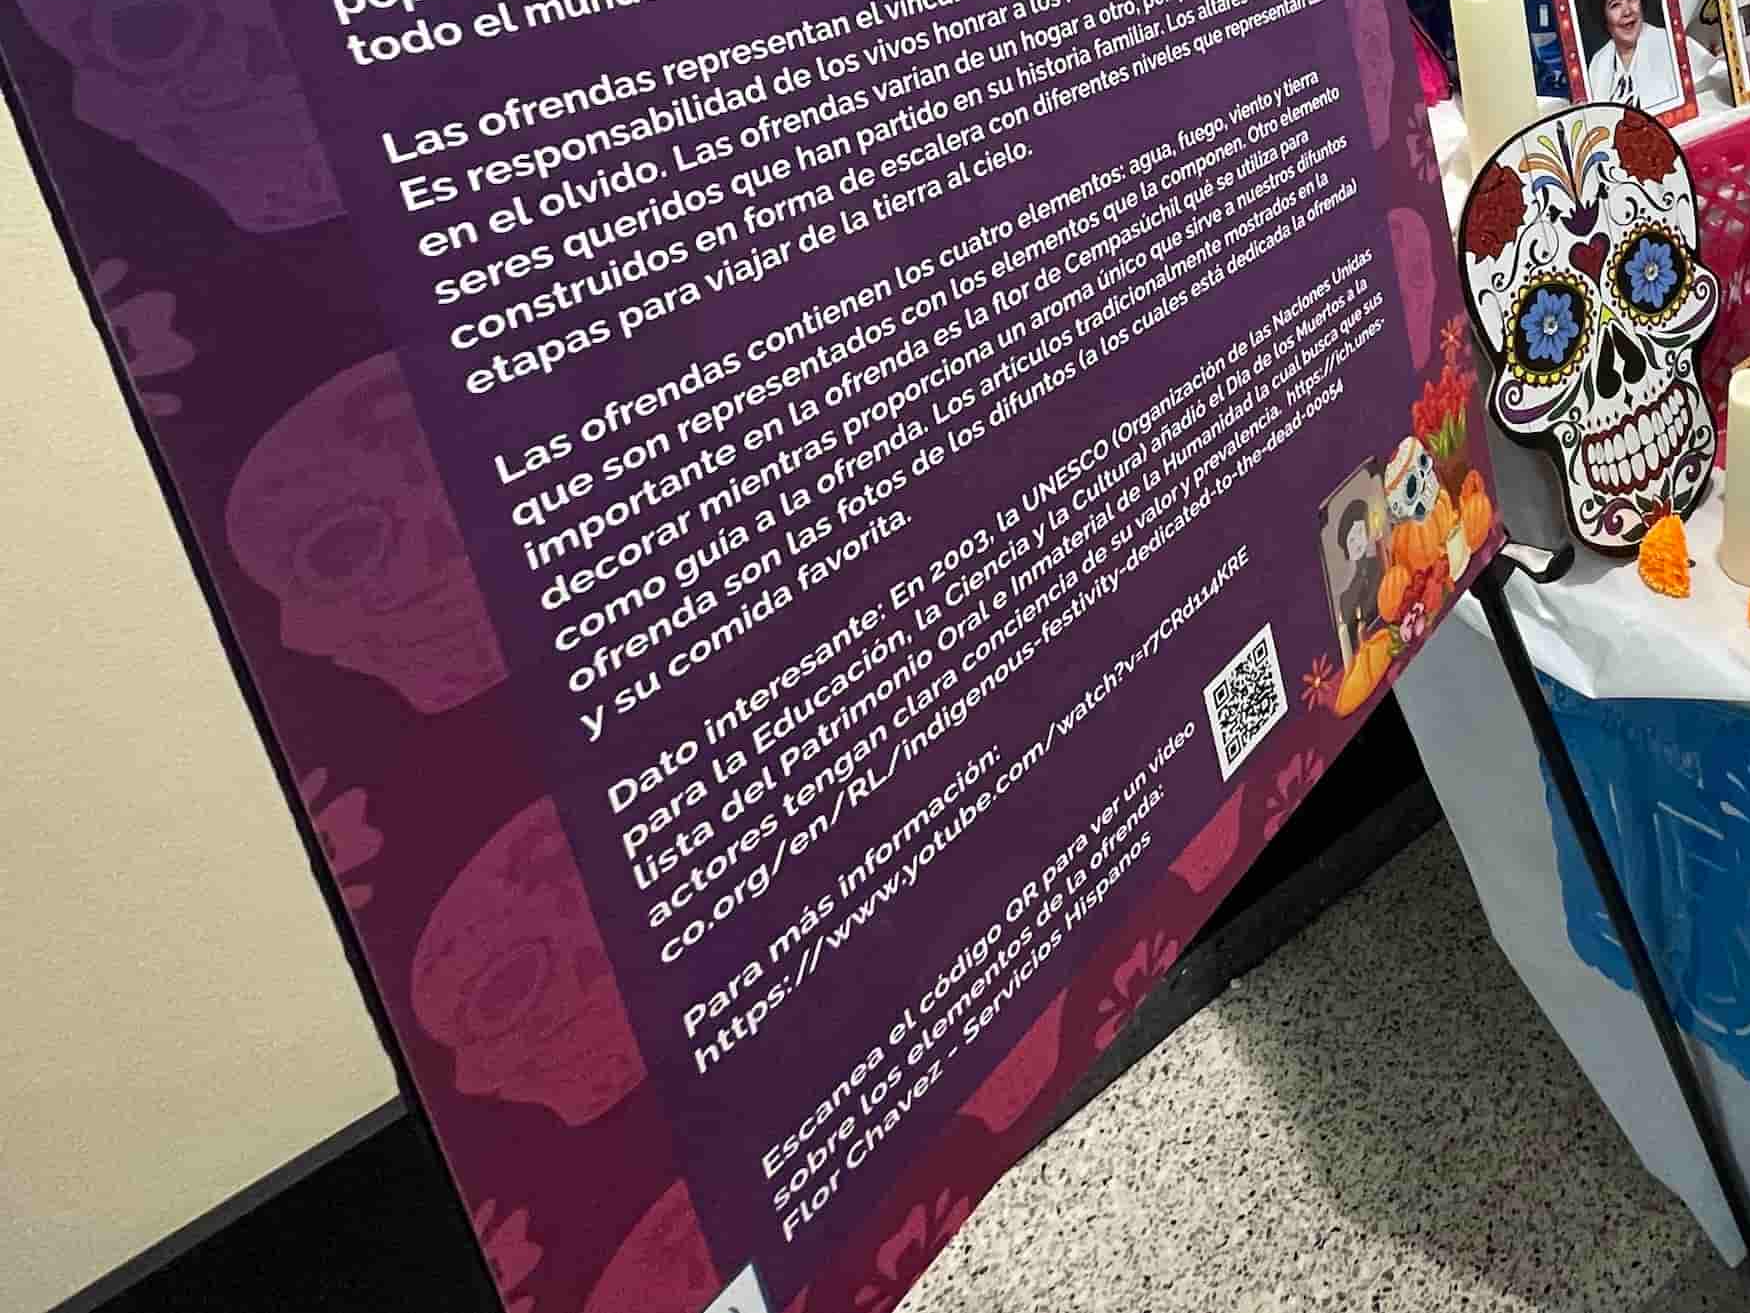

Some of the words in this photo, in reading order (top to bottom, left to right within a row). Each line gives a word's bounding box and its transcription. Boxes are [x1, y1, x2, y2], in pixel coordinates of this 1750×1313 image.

[347, 19, 462, 65] todo
[473, 2, 519, 37] el
[382, 122, 469, 164] Las
[478, 70, 656, 136] ofrendas
[662, 15, 851, 85] representan
[855, 1, 884, 29] el
[494, 433, 572, 484] Las
[581, 352, 741, 442] ofrendas
[747, 279, 892, 361] contienen
[894, 258, 935, 289] los
[939, 220, 1013, 267] cuatro
[1017, 164, 1126, 229] elementos:
[1128, 143, 1176, 174] agua,
[1177, 117, 1228, 150] fuego,
[1228, 93, 1272, 124] viento
[1272, 87, 1281, 107] y
[1282, 71, 1319, 97] tierra
[580, 704, 603, 742] y
[614, 671, 661, 713] su
[668, 585, 793, 676] comida
[797, 510, 912, 590] favorita.
[607, 740, 698, 813] Dato
[703, 603, 885, 744] interesante:
[889, 575, 924, 610] En
[929, 528, 994, 583] 2003,
[996, 508, 1020, 532] la
[1021, 439, 1109, 511] UNESCO
[1111, 357, 1226, 448] (Organización
[1227, 341, 1248, 363] de
[1248, 323, 1272, 348] las
[1271, 279, 1331, 331] Naciones
[1331, 248, 1372, 285] Unidas
[649, 813, 778, 927] actores
[782, 724, 887, 816] tengan
[893, 669, 958, 728] clara
[961, 570, 1078, 672] conciencia
[1081, 546, 1107, 574] de
[1110, 523, 1133, 551] su
[1134, 485, 1178, 529] valor
[1179, 476, 1190, 498] y
[1192, 405, 1282, 488] prevalencia.
[683, 961, 763, 1038] Para
[769, 894, 834, 962] más
[837, 744, 1000, 898] información:
[762, 1046, 884, 1179] Escanea
[889, 1008, 917, 1044] el
[919, 923, 1002, 1013] código
[1005, 881, 1039, 922] QR
[1042, 833, 1088, 892] para
[1090, 796, 1120, 834] ver
[1123, 771, 1146, 801] un
[1148, 721, 1195, 773] video
[773, 1116, 855, 1210] sobre
[860, 1065, 902, 1115] los
[907, 925, 1033, 1065] elementos
[1036, 893, 1063, 927] de
[1065, 869, 1087, 894] la
[1089, 783, 1164, 869] ofrenda:
[782, 1168, 840, 1242] Flor
[846, 1059, 943, 1168] Chavez
[962, 928, 1062, 1044] Servicios
[1064, 831, 1151, 931] Hispanos
